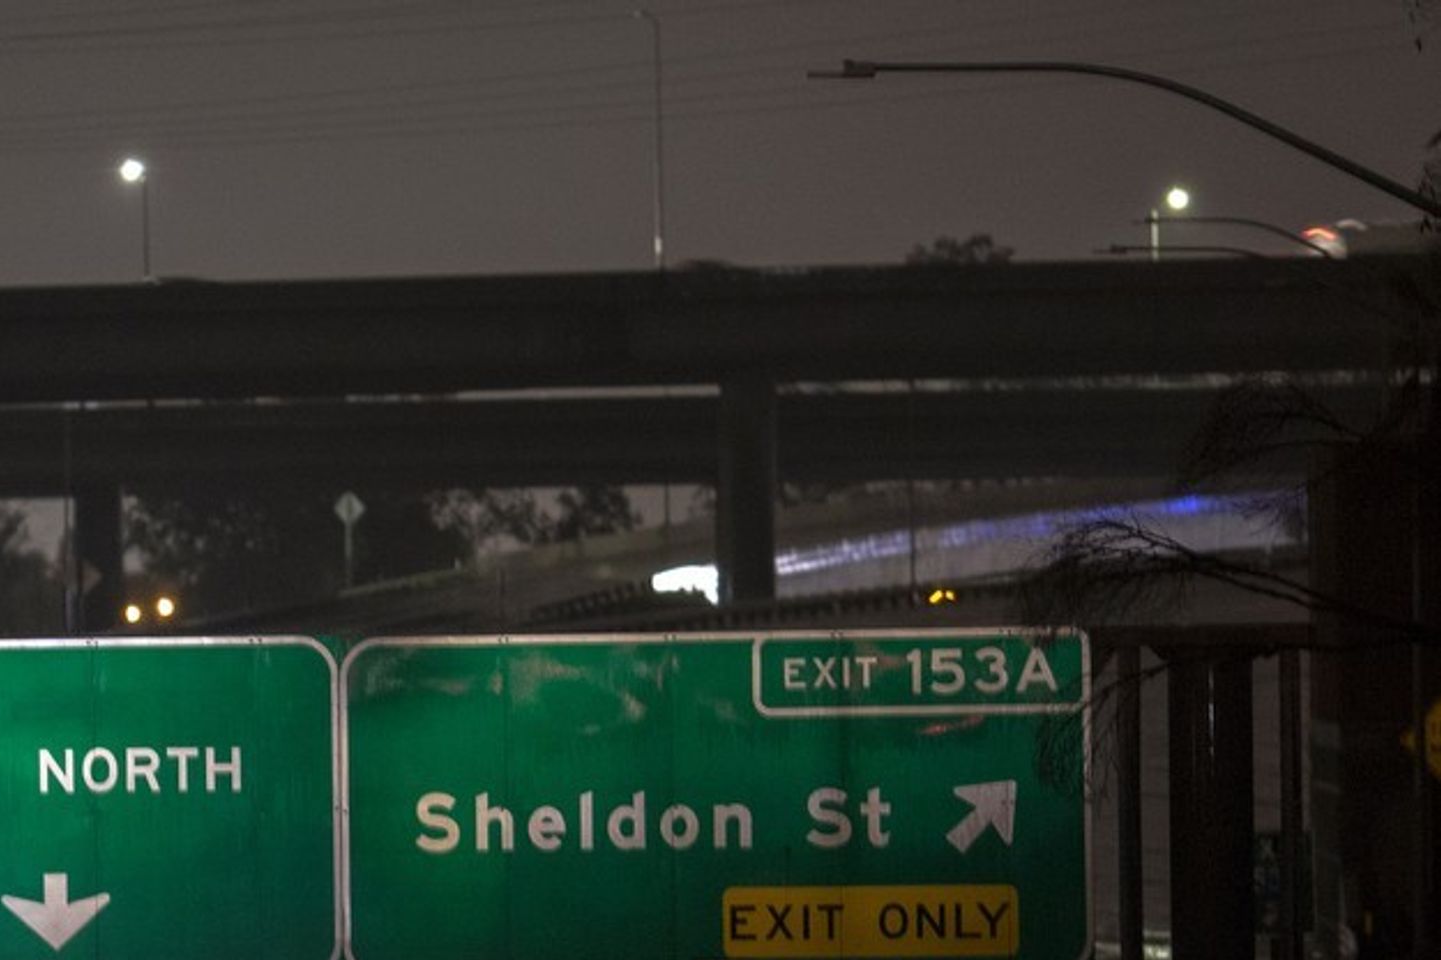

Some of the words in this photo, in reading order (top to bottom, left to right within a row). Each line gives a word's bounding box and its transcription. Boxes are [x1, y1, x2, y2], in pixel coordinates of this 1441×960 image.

[782, 656, 878, 690] EXIT
[906, 648, 1058, 694] 153A
[38, 745, 243, 793] NORTH
[414, 791, 754, 853] Sheldon
[806, 787, 891, 848] St
[729, 905, 844, 941] EXIT
[878, 902, 1009, 940] ONLY
